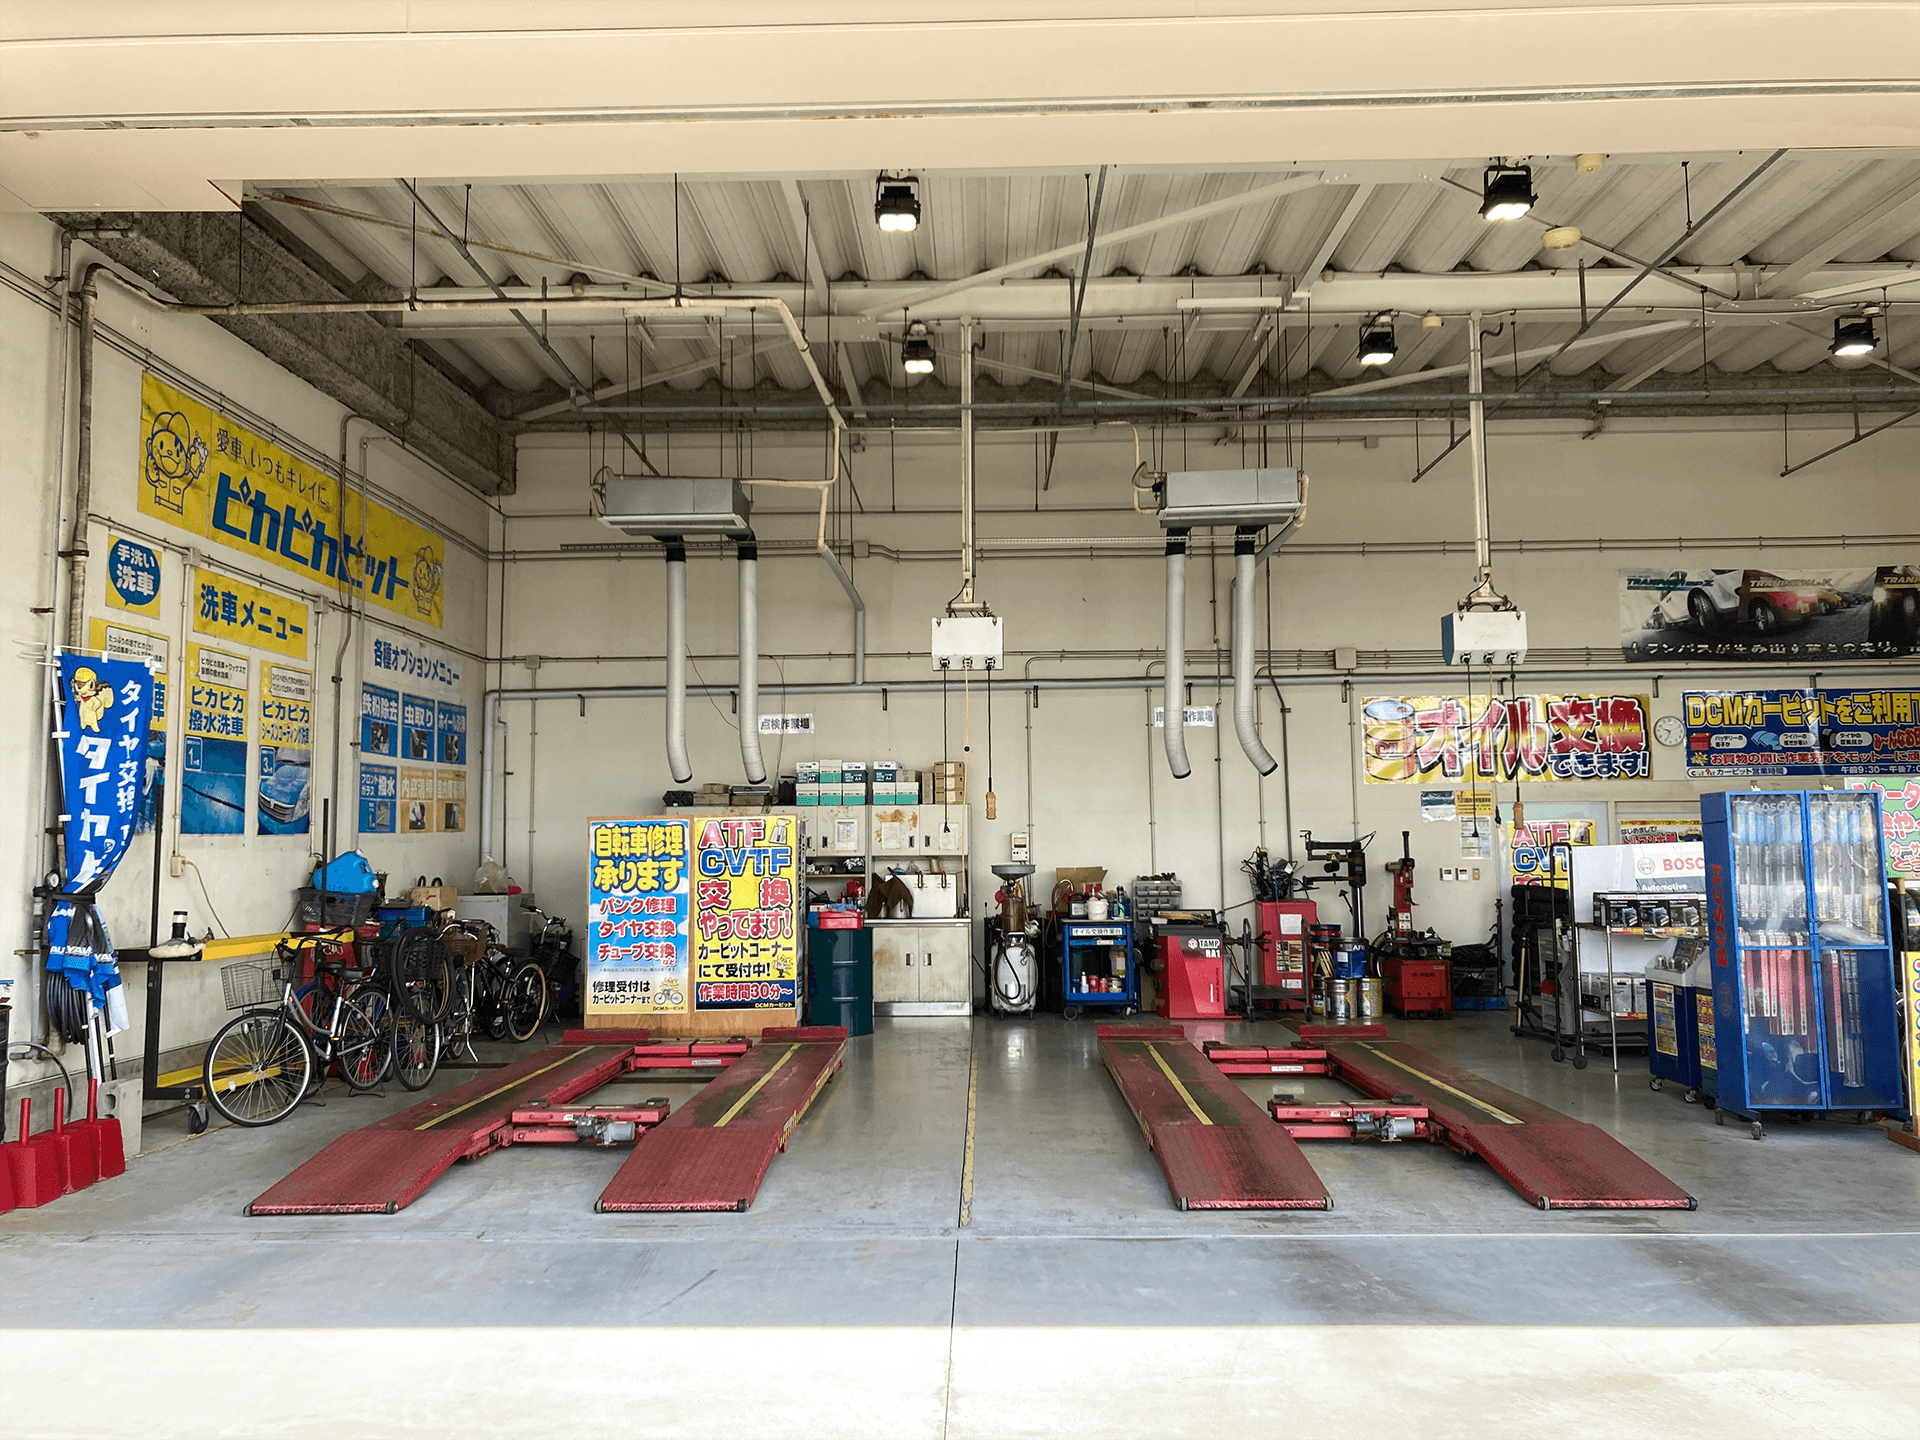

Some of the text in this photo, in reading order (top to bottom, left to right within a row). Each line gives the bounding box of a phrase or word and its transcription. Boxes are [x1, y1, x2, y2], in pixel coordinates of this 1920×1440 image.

[212, 471, 409, 600] ピカピカピット
[117, 543, 155, 568] 手洗い
[116, 563, 155, 596] 洗車
[200, 583, 304, 640] 洗車メニュー
[373, 638, 460, 686] 各種オプションメニュー
[190, 685, 245, 714] ピカピカ
[262, 699, 311, 724] ピカピカ
[188, 707, 245, 737] 撥水洗車
[403, 704, 434, 728] 虫取り
[760, 717, 810, 730] 点検作業場
[1551, 750, 1648, 777] できます!
[595, 824, 684, 858] 自転車修理
[698, 820, 765, 848] ATF
[1513, 823, 1569, 847] ATF
[1620, 826, 1657, 835] はじめまして!
[700, 846, 792, 876] CVTF
[594, 857, 685, 892] 承ります
[1641, 883, 1688, 891] Automotive
[599, 896, 677, 915] パンク修理
[1712, 864, 1728, 967] BOSCH
[599, 919, 677, 938] タイヤ交換
[697, 909, 793, 940] やってます!
[598, 942, 677, 960] チューブ交換
[698, 941, 793, 960] カーピットコーナー
[1200, 939, 1219, 948] TAMP
[1205, 950, 1220, 958] RA1
[662, 958, 677, 966] など
[698, 963, 771, 978] にて受付中!
[592, 980, 651, 993] 修理受付は
[592, 993, 651, 1004] カーピットコーナーまで
